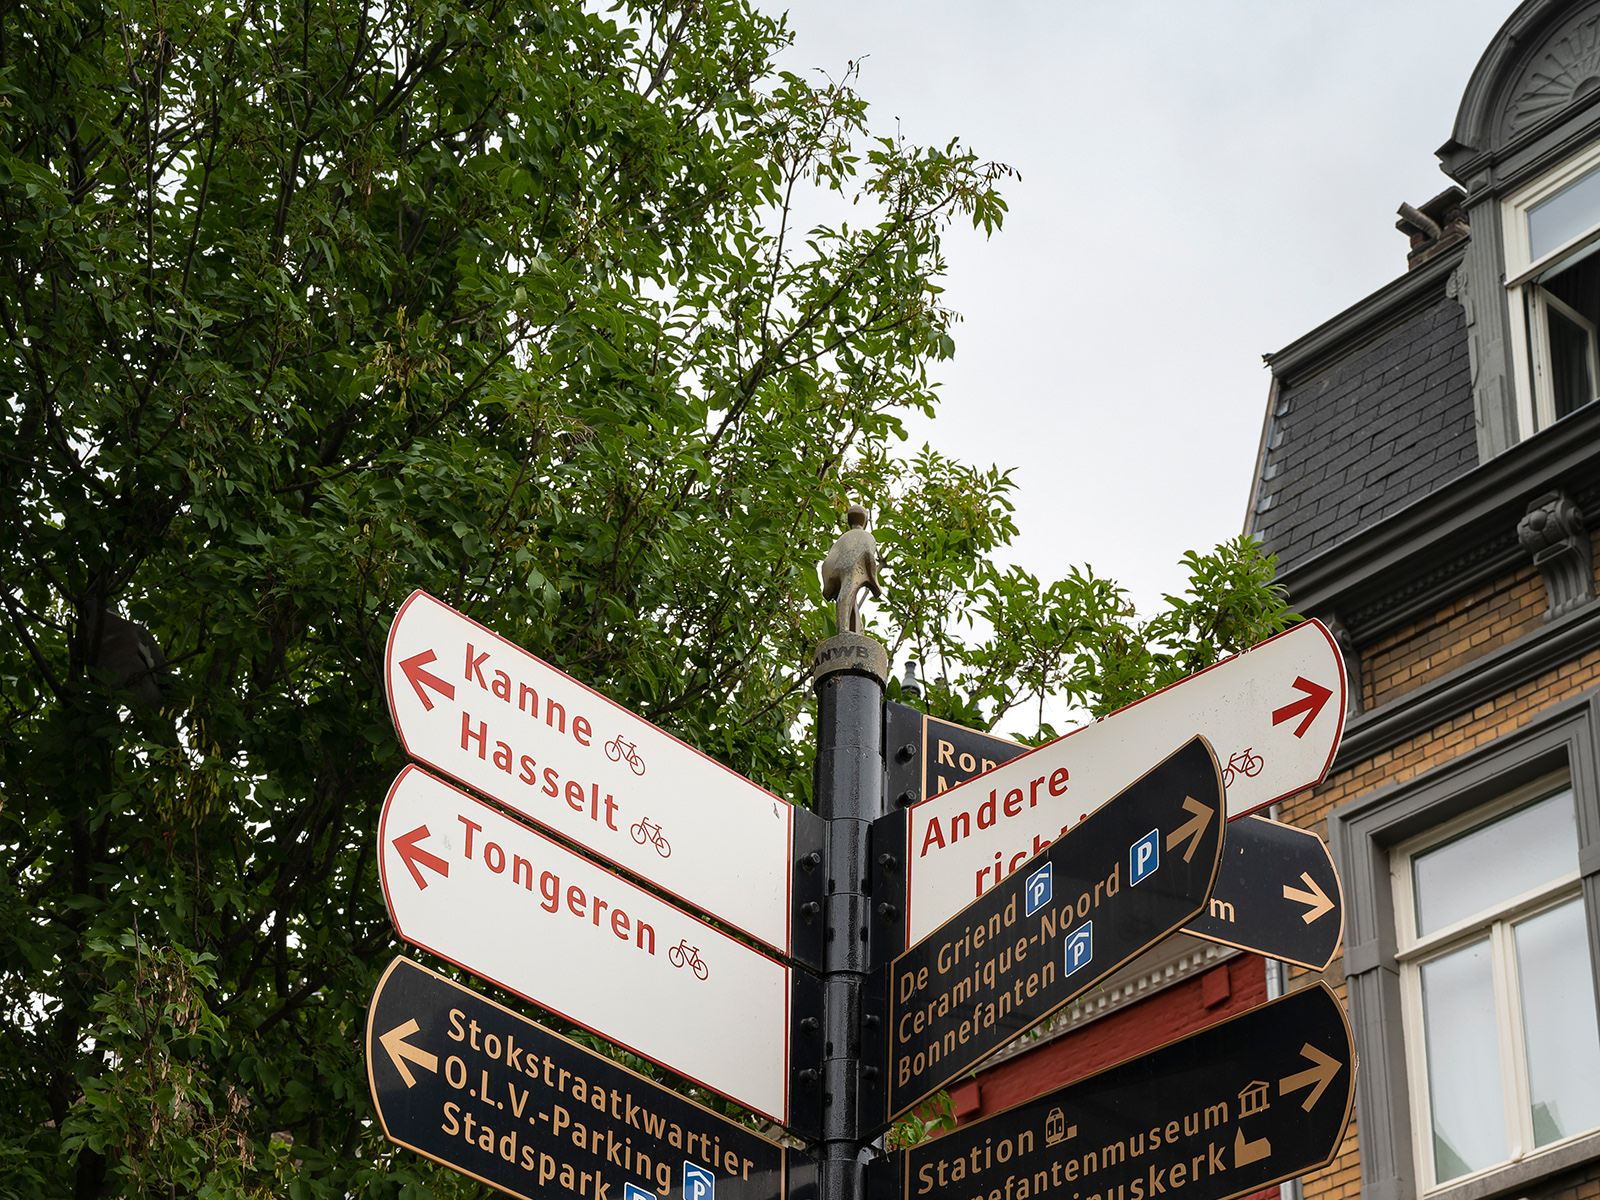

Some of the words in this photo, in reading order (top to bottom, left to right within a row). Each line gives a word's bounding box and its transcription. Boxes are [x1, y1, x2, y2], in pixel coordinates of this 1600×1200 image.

[464, 643, 593, 748] Kanne
[460, 711, 619, 832] Hasselt
[920, 766, 1069, 858] Andere
[457, 814, 656, 956] Tongeren
[899, 863, 1120, 1044] Ceramique-Noord
[900, 963, 928, 1004] De
[937, 892, 1017, 975] Griend
[899, 960, 1055, 1088] Bonnefanten
[445, 1055, 671, 1197] O.L.V.-Parking
[447, 1008, 754, 1182] Stokstraatkwartier
[917, 1127, 1034, 1195] Station
